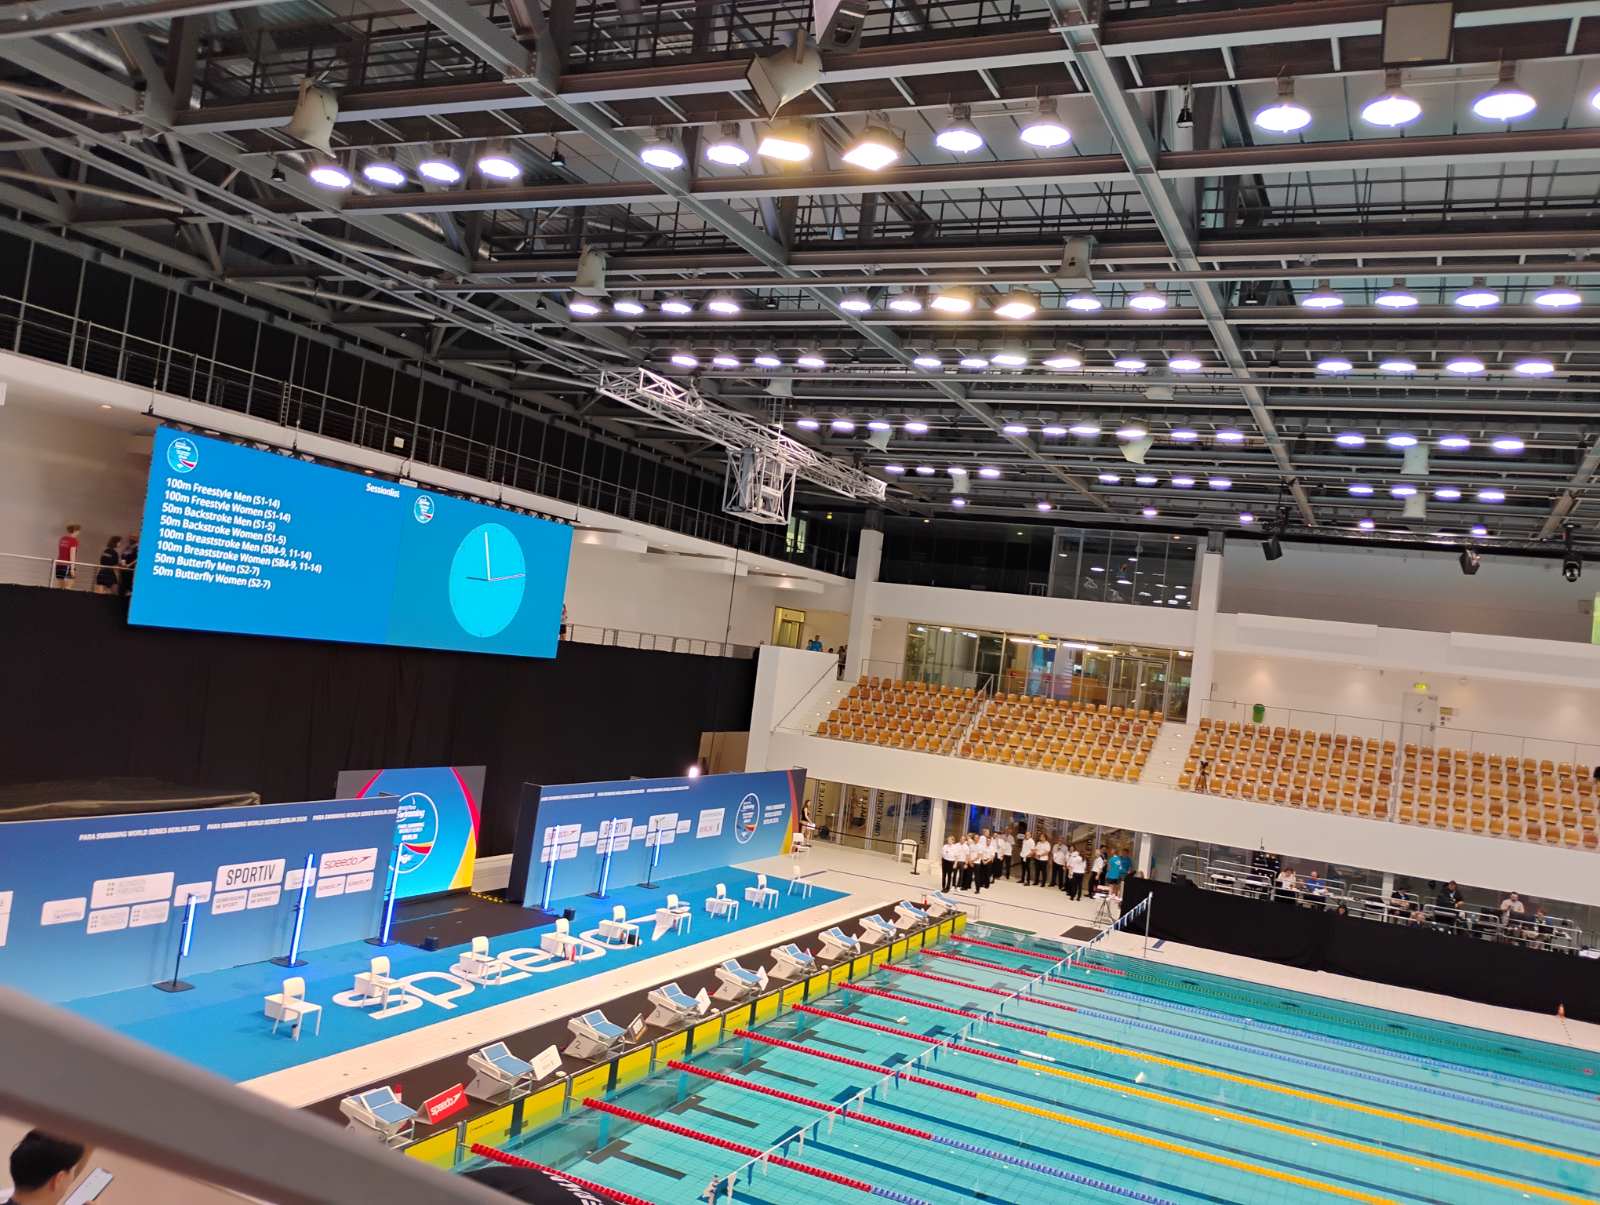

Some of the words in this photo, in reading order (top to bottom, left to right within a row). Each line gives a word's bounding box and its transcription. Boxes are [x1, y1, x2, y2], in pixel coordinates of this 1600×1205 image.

[166, 477, 192, 491] 100m
[193, 483, 233, 500] Freestyle
[233, 491, 252, 503] Men
[253, 495, 280, 509] (S1-14)
[366, 483, 400, 498] Sessionlist
[161, 502, 183, 515] 50m
[184, 506, 232, 524] Backstroke
[233, 515, 252, 527] Men
[253, 519, 276, 532] (S1-5)
[164, 490, 190, 504] 100m
[191, 496, 231, 512] Freestyle
[231, 503, 263, 517] Women
[264, 509, 291, 523] (S1-14)
[160, 515, 181, 527] 50m
[182, 518, 231, 536] Backstroke
[231, 527, 263, 541] Women
[264, 533, 287, 545] (S1-5)
[157, 540, 182, 553] 100m
[184, 545, 239, 562] Breaststroke
[239, 552, 271, 566] Women
[300, 561, 323, 574] 11-14)
[159, 528, 184, 540] 100m
[186, 532, 241, 550] Breaststroke
[241, 540, 260, 552] Men
[289, 548, 312, 561] 11-14)
[154, 552, 176, 564] 50m
[177, 555, 216, 571] Butterfly
[217, 561, 236, 573] Men
[236, 564, 260, 577] (S2-7)
[153, 565, 174, 577] 50m
[175, 568, 215, 583] Butterfly
[215, 574, 247, 586] Women
[248, 577, 271, 590] (S2-7)
[225, 864, 276, 886] SPORTIV
[324, 856, 358, 869] speedo
[574, 1040, 582, 1049] 2
[430, 1097, 454, 1116] speedo
